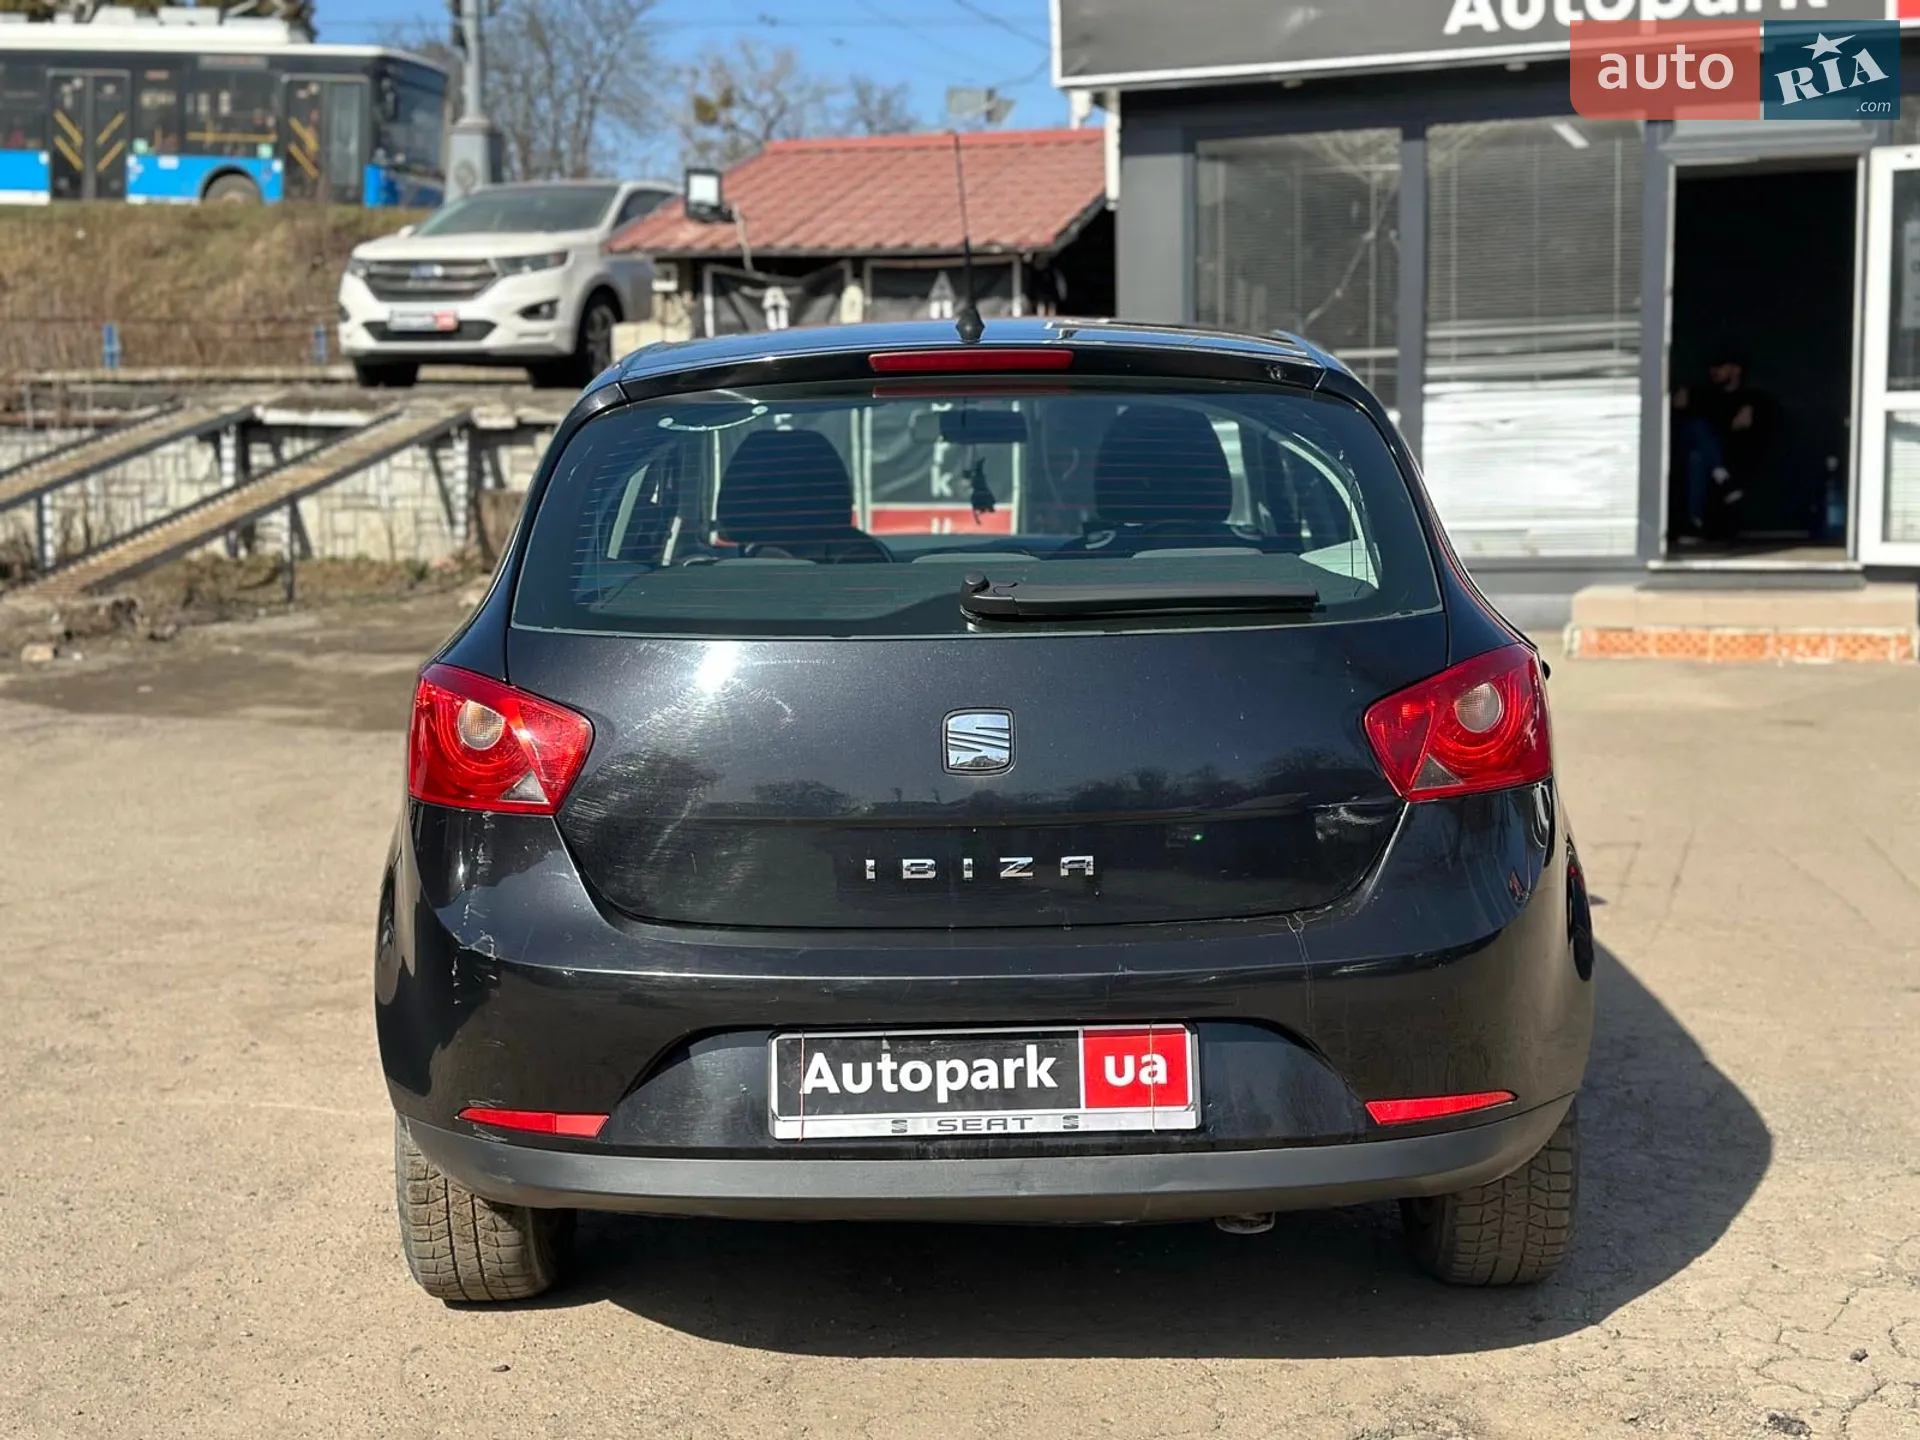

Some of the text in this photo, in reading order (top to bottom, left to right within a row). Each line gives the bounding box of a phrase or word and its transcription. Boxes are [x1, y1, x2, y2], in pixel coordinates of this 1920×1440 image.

[865, 855, 1095, 881] IBIZA
[802, 1044, 1168, 1104] Autopark ua
[937, 1117, 1034, 1132] SEAT
